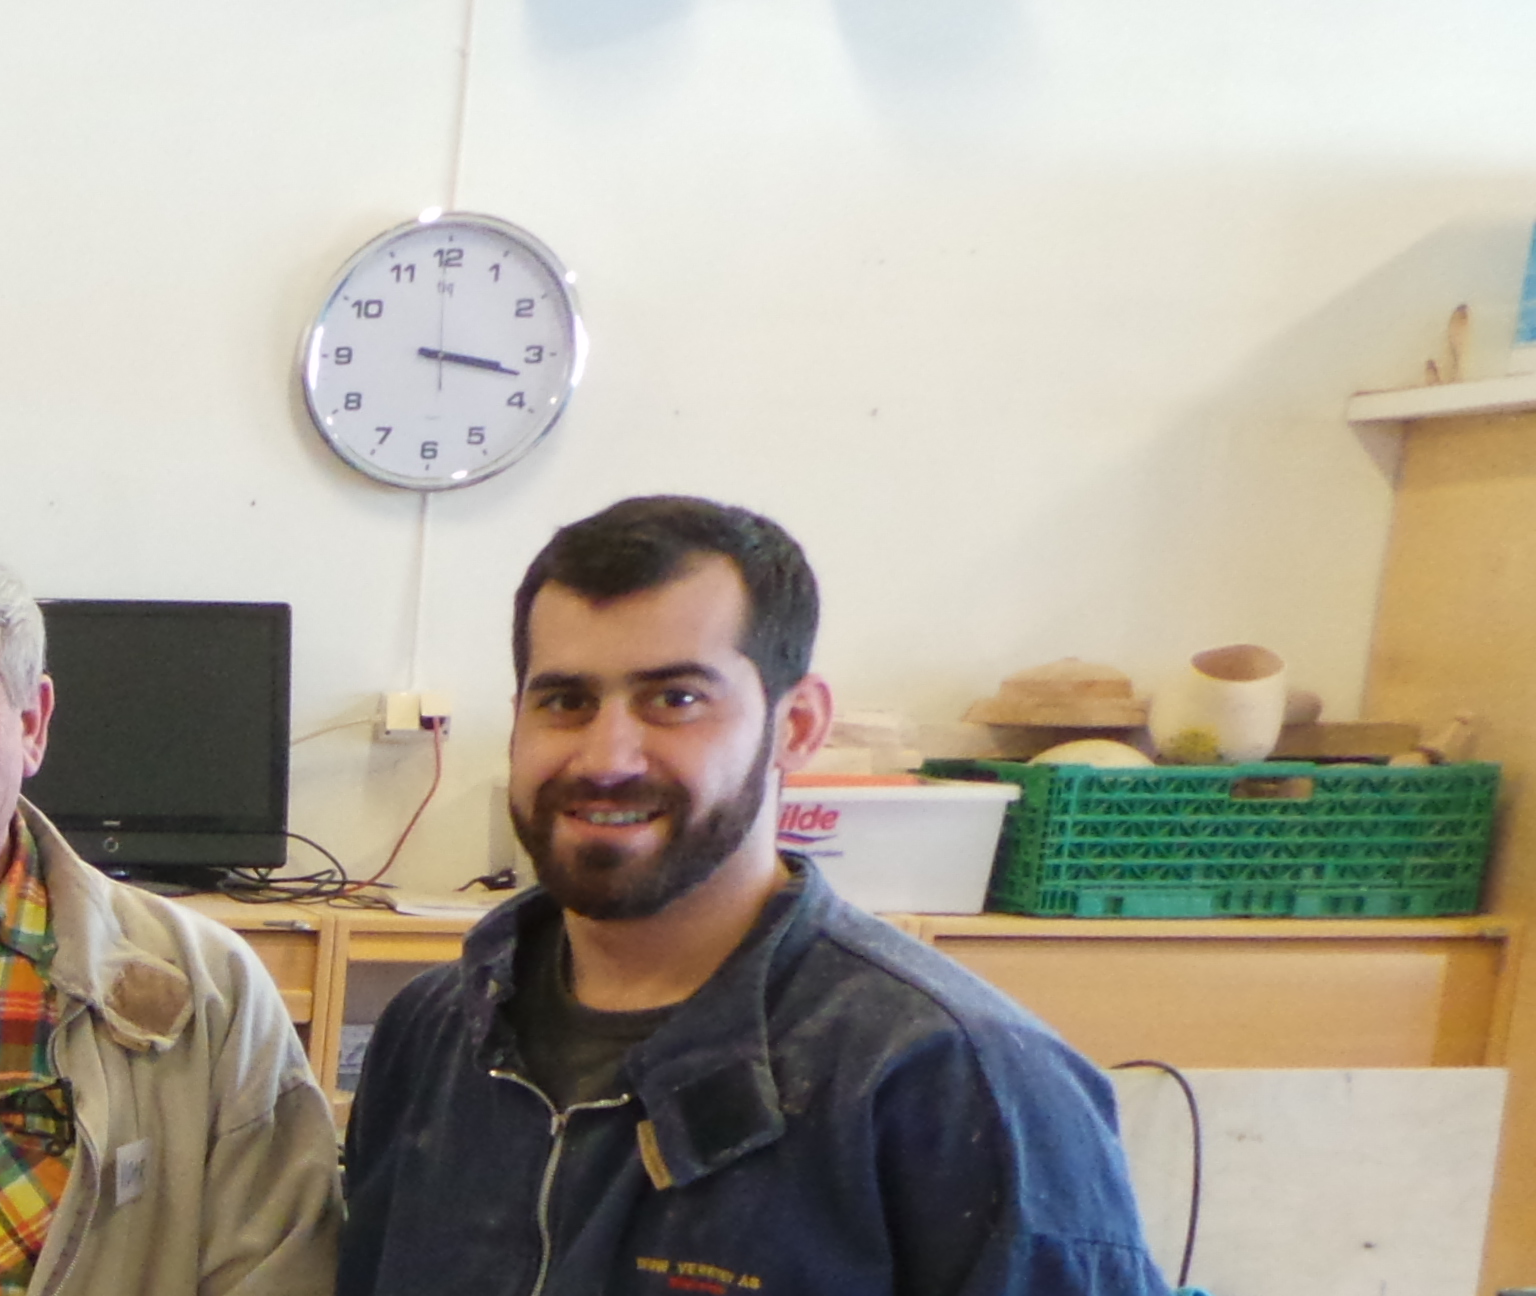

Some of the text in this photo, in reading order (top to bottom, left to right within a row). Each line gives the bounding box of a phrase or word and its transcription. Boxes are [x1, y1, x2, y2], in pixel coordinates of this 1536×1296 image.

[433, 248, 464, 267] 12
[390, 263, 416, 283] 11
[489, 263, 501, 282] 1
[352, 299, 383, 319] 10
[514, 298, 535, 318] 2
[334, 346, 353, 365] 9
[524, 345, 544, 364] 3
[344, 392, 363, 411] 8
[506, 391, 526, 409] 4
[375, 426, 393, 445] 7
[467, 426, 485, 445] 5
[420, 441, 438, 460] 6
